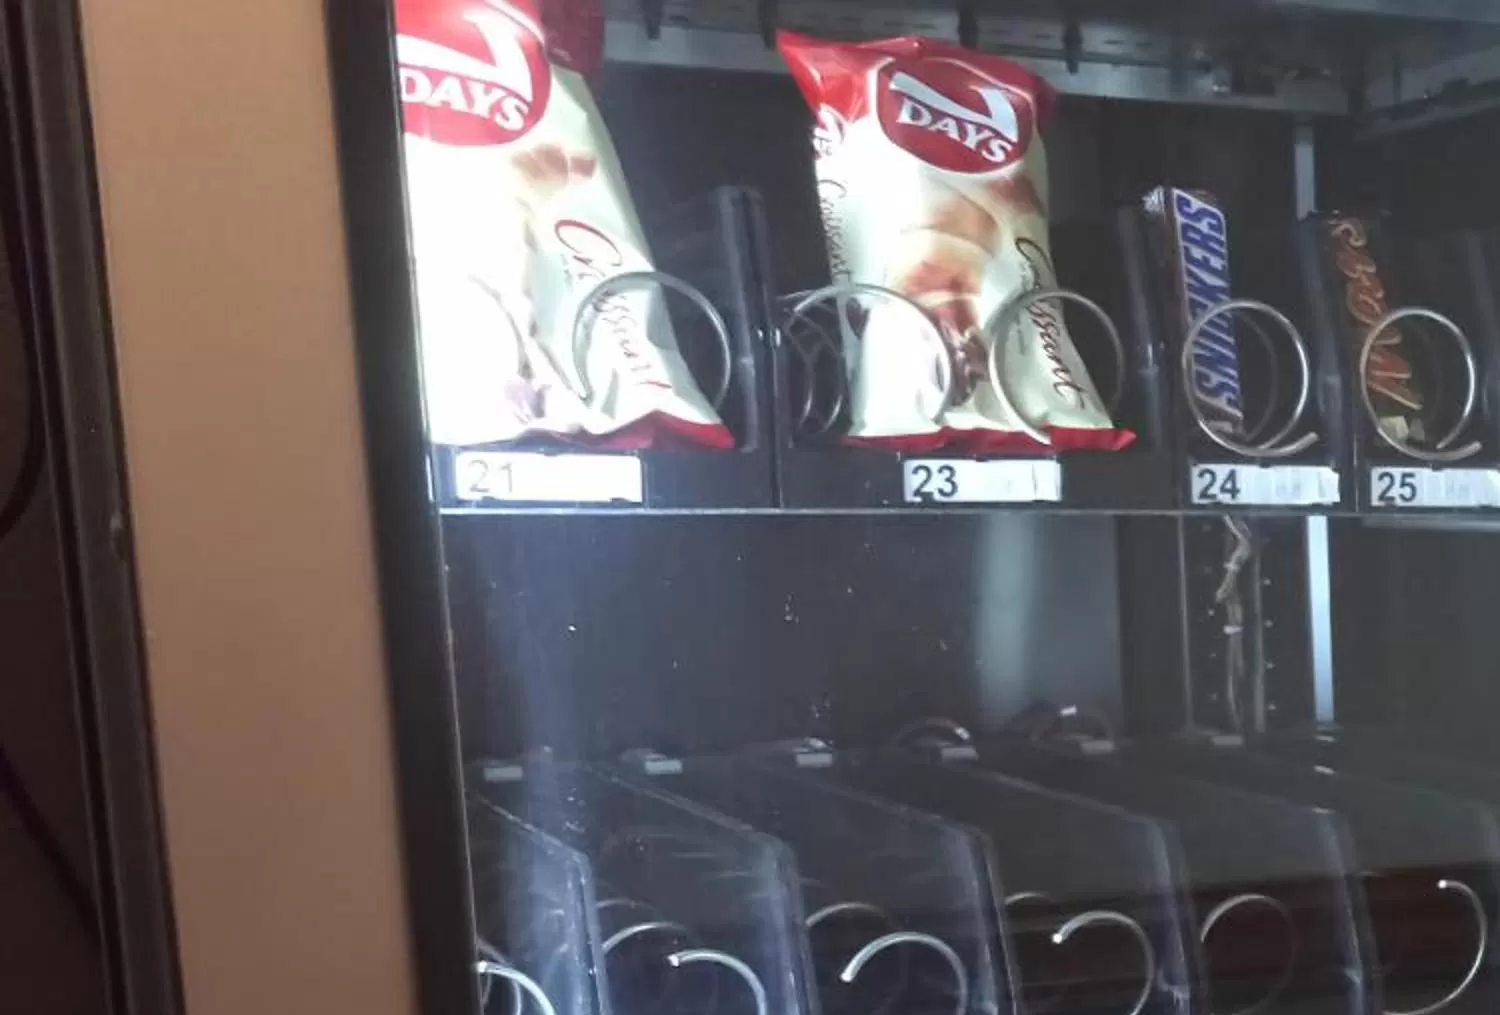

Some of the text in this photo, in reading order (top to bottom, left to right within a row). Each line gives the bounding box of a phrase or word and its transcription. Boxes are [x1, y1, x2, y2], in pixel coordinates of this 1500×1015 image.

[400, 69, 529, 131] DAYS
[896, 98, 1013, 163] DAYS
[468, 459, 513, 493] 21
[911, 465, 959, 499] 23
[1197, 469, 1240, 500] 24
[1377, 472, 1417, 503] 25
